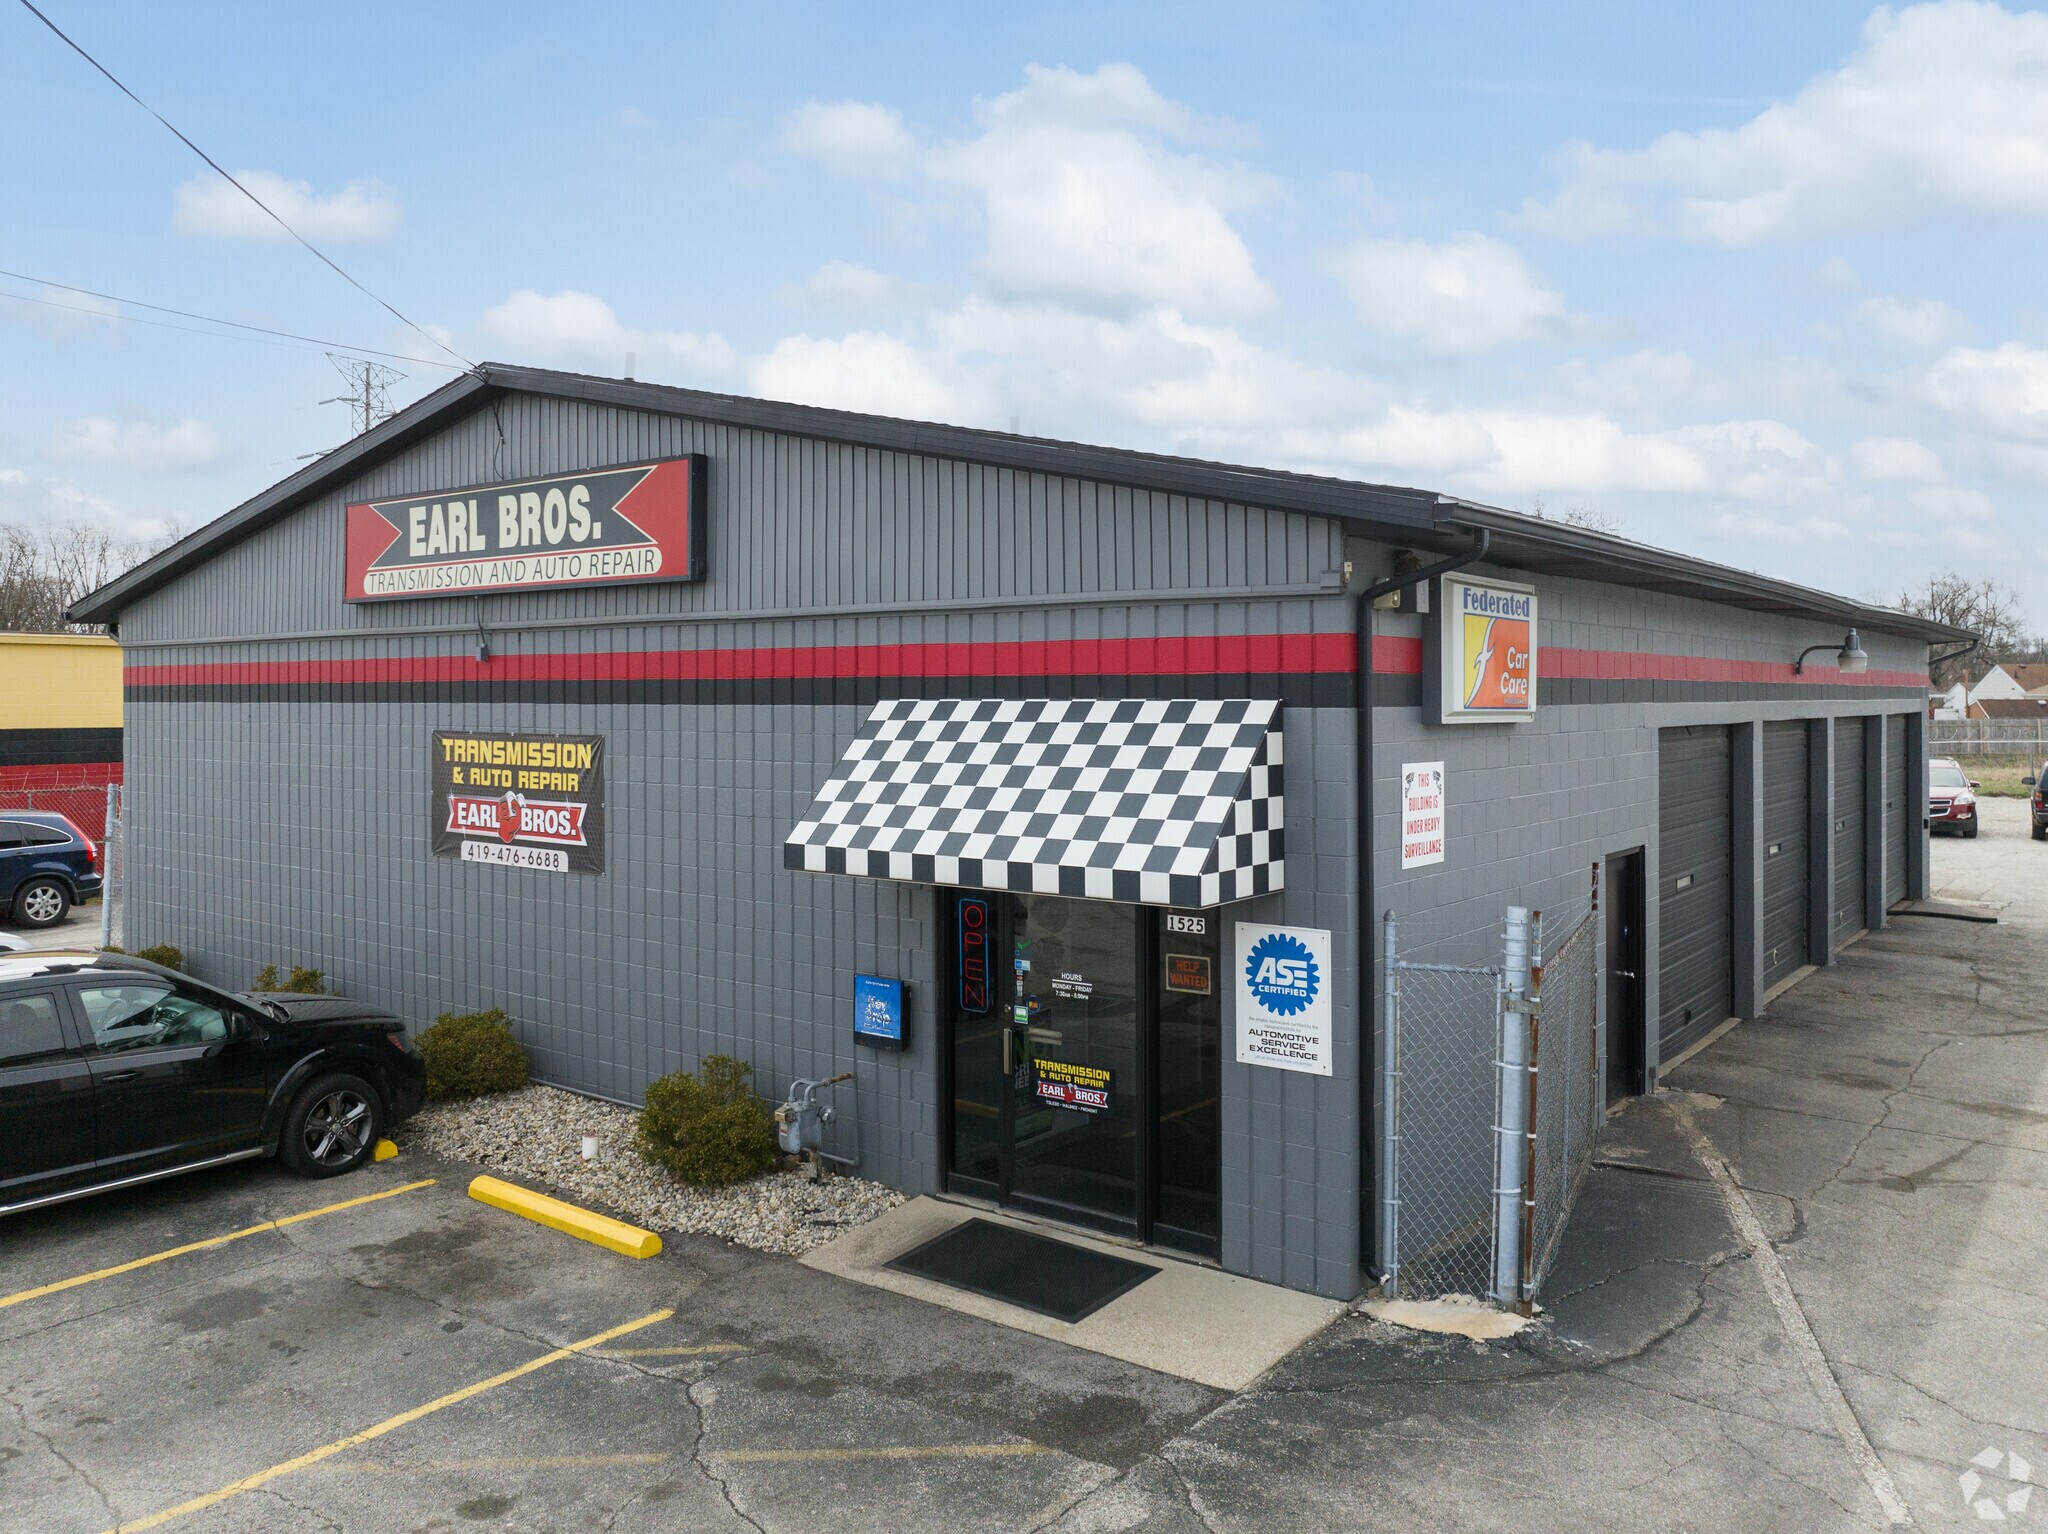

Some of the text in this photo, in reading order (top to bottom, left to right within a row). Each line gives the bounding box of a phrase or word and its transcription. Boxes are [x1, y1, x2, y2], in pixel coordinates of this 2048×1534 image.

[409, 484, 601, 557] EARL BROS.
[369, 549, 656, 593] TRANSMISSION AND AUTO REPAIR
[1463, 587, 1530, 618] Federated
[1507, 646, 1528, 670] Car
[1500, 671, 1527, 695] Care
[442, 739, 592, 769] TRANSMISSION
[453, 767, 579, 792] & AUTO REPAIR
[1418, 773, 1429, 787] THIS
[1409, 795, 1438, 812] BUILDING IS
[457, 802, 576, 836] EARL BROS.
[1407, 817, 1440, 835] UNDER HEAVY
[468, 844, 560, 868] 419-476-6688
[1405, 839, 1441, 858] SURVEILLANCE
[1169, 917, 1203, 933] 1525
[965, 905, 984, 1007] OPEN
[1176, 960, 1200, 972] HELP
[1255, 957, 1307, 988] ASE
[1052, 982, 1072, 991] MONDAY
[1061, 972, 1082, 982] HOURS
[1169, 973, 1207, 987] WANTED
[1258, 984, 1306, 997] CERTIFIED
[1249, 1028, 1319, 1044] AUTOMOTIVE
[1261, 1038, 1306, 1051] SERVICE
[1249, 1044, 1318, 1061] EXCELLENCE
[1034, 1059, 1110, 1081] TRANSMISSION
[1040, 1070, 1046, 1078] &
[1049, 1072, 1071, 1082] AUTO
[1074, 1076, 1104, 1088] REPAIR
[1042, 1084, 1103, 1104] EARL BROS.
